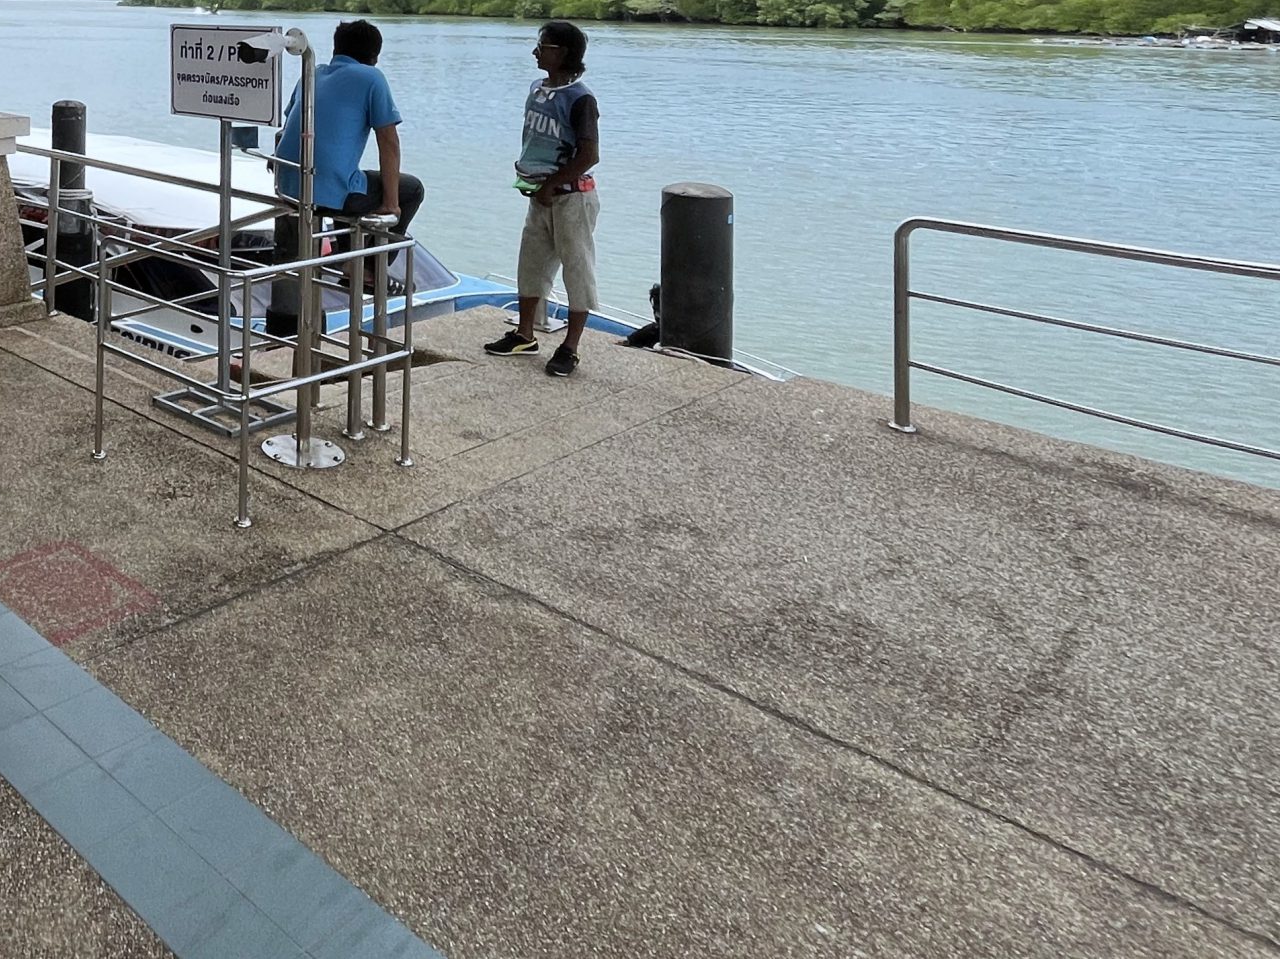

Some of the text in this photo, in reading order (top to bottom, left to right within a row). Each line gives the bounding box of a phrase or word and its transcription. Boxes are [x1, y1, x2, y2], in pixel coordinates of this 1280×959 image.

[180, 37, 203, 60] ท่าที่
[206, 46, 215, 61] 2
[202, 91, 240, 106] ก่อนลงเรือ
